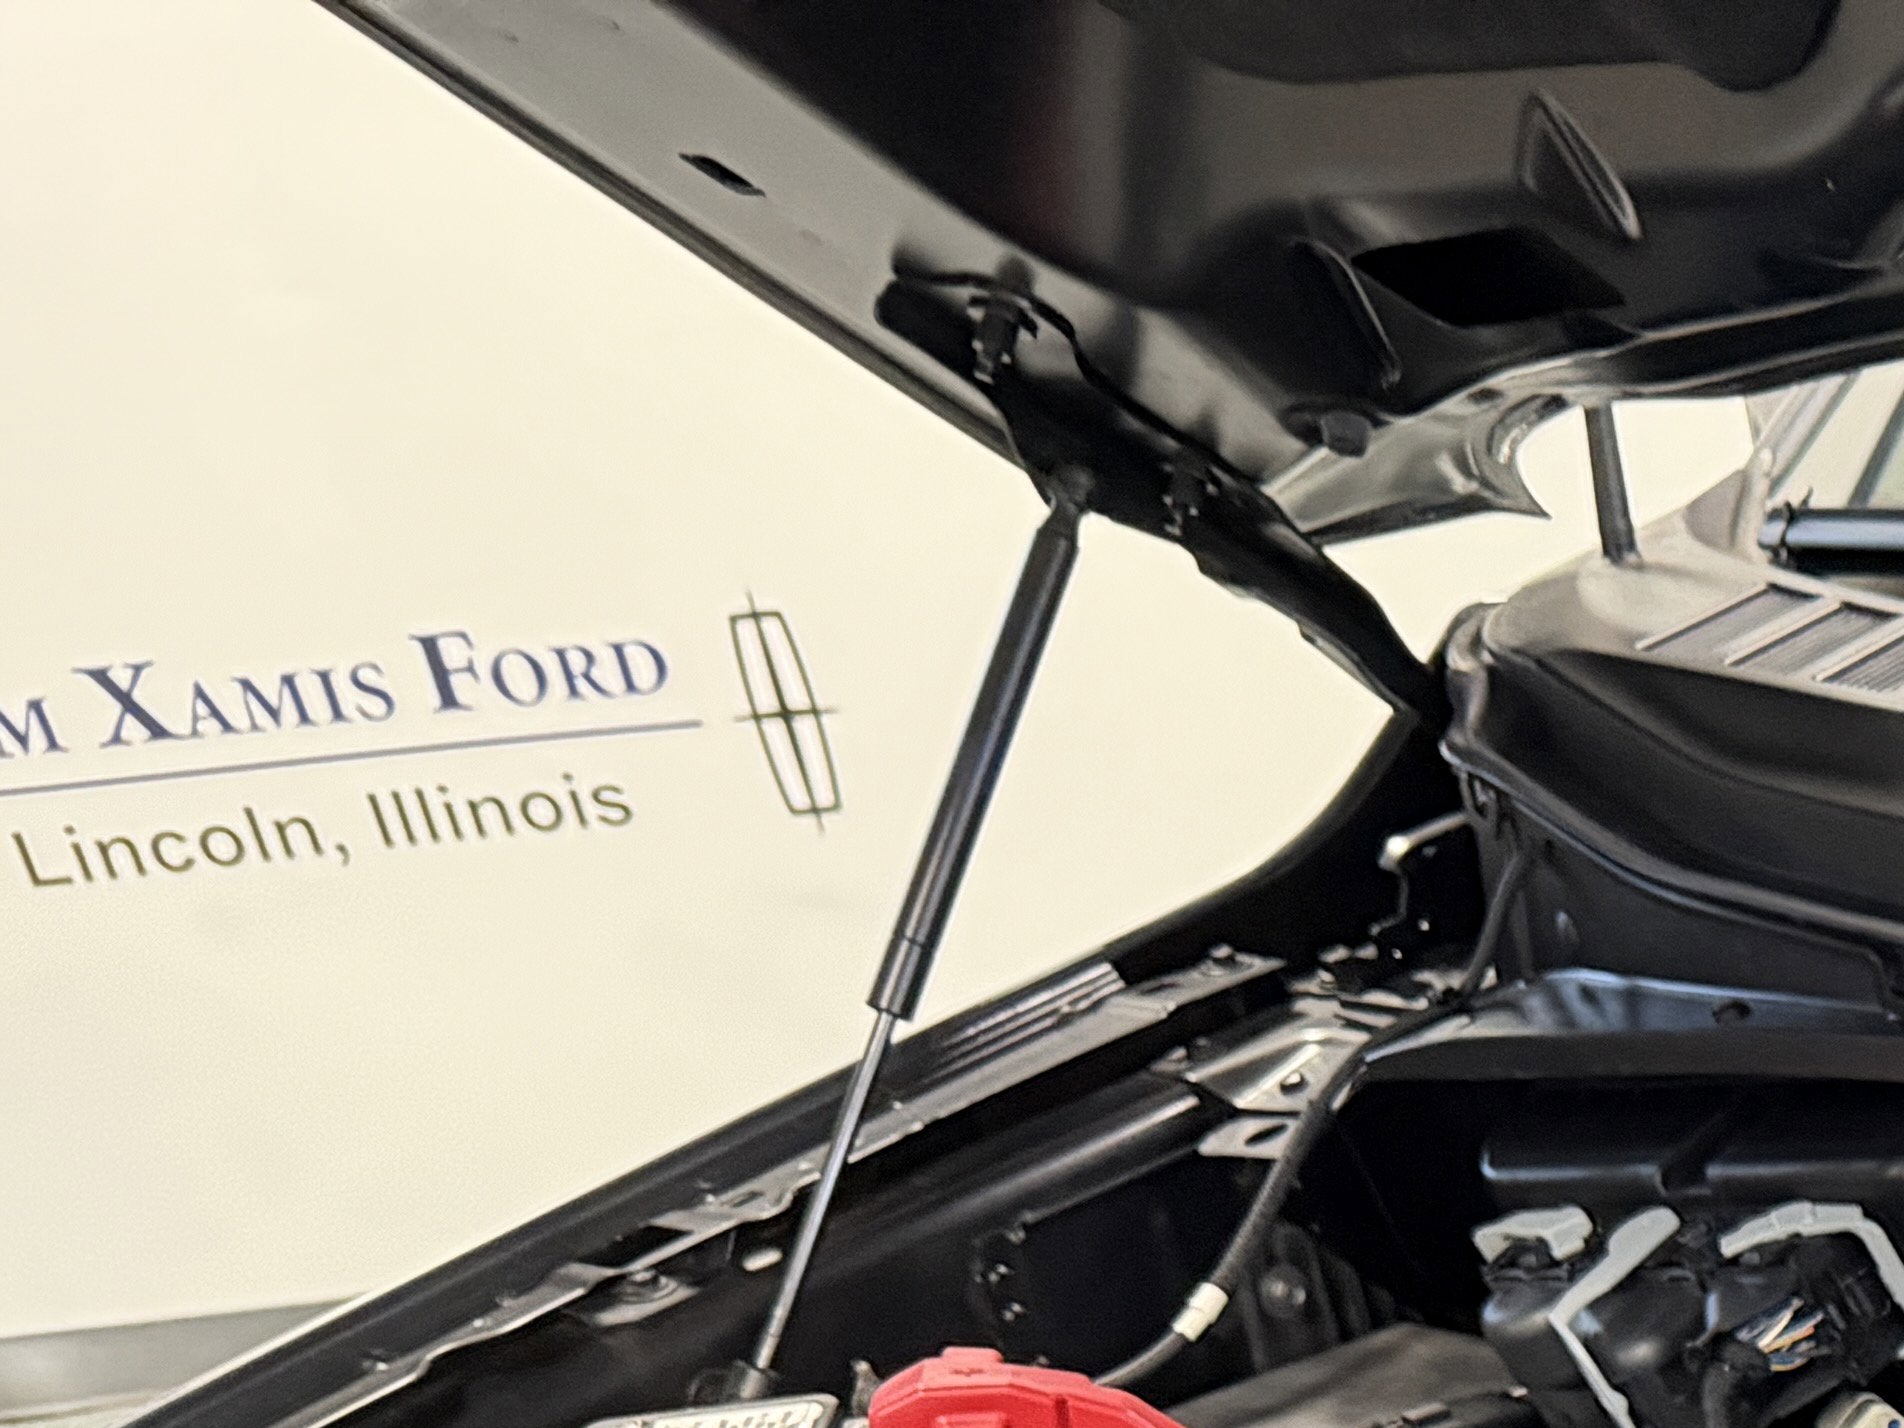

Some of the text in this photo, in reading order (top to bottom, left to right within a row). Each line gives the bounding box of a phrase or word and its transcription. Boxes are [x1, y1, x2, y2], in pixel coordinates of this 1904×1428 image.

[410, 629, 671, 715] FORD
[12, 773, 634, 888] Lincoln, Illinois
